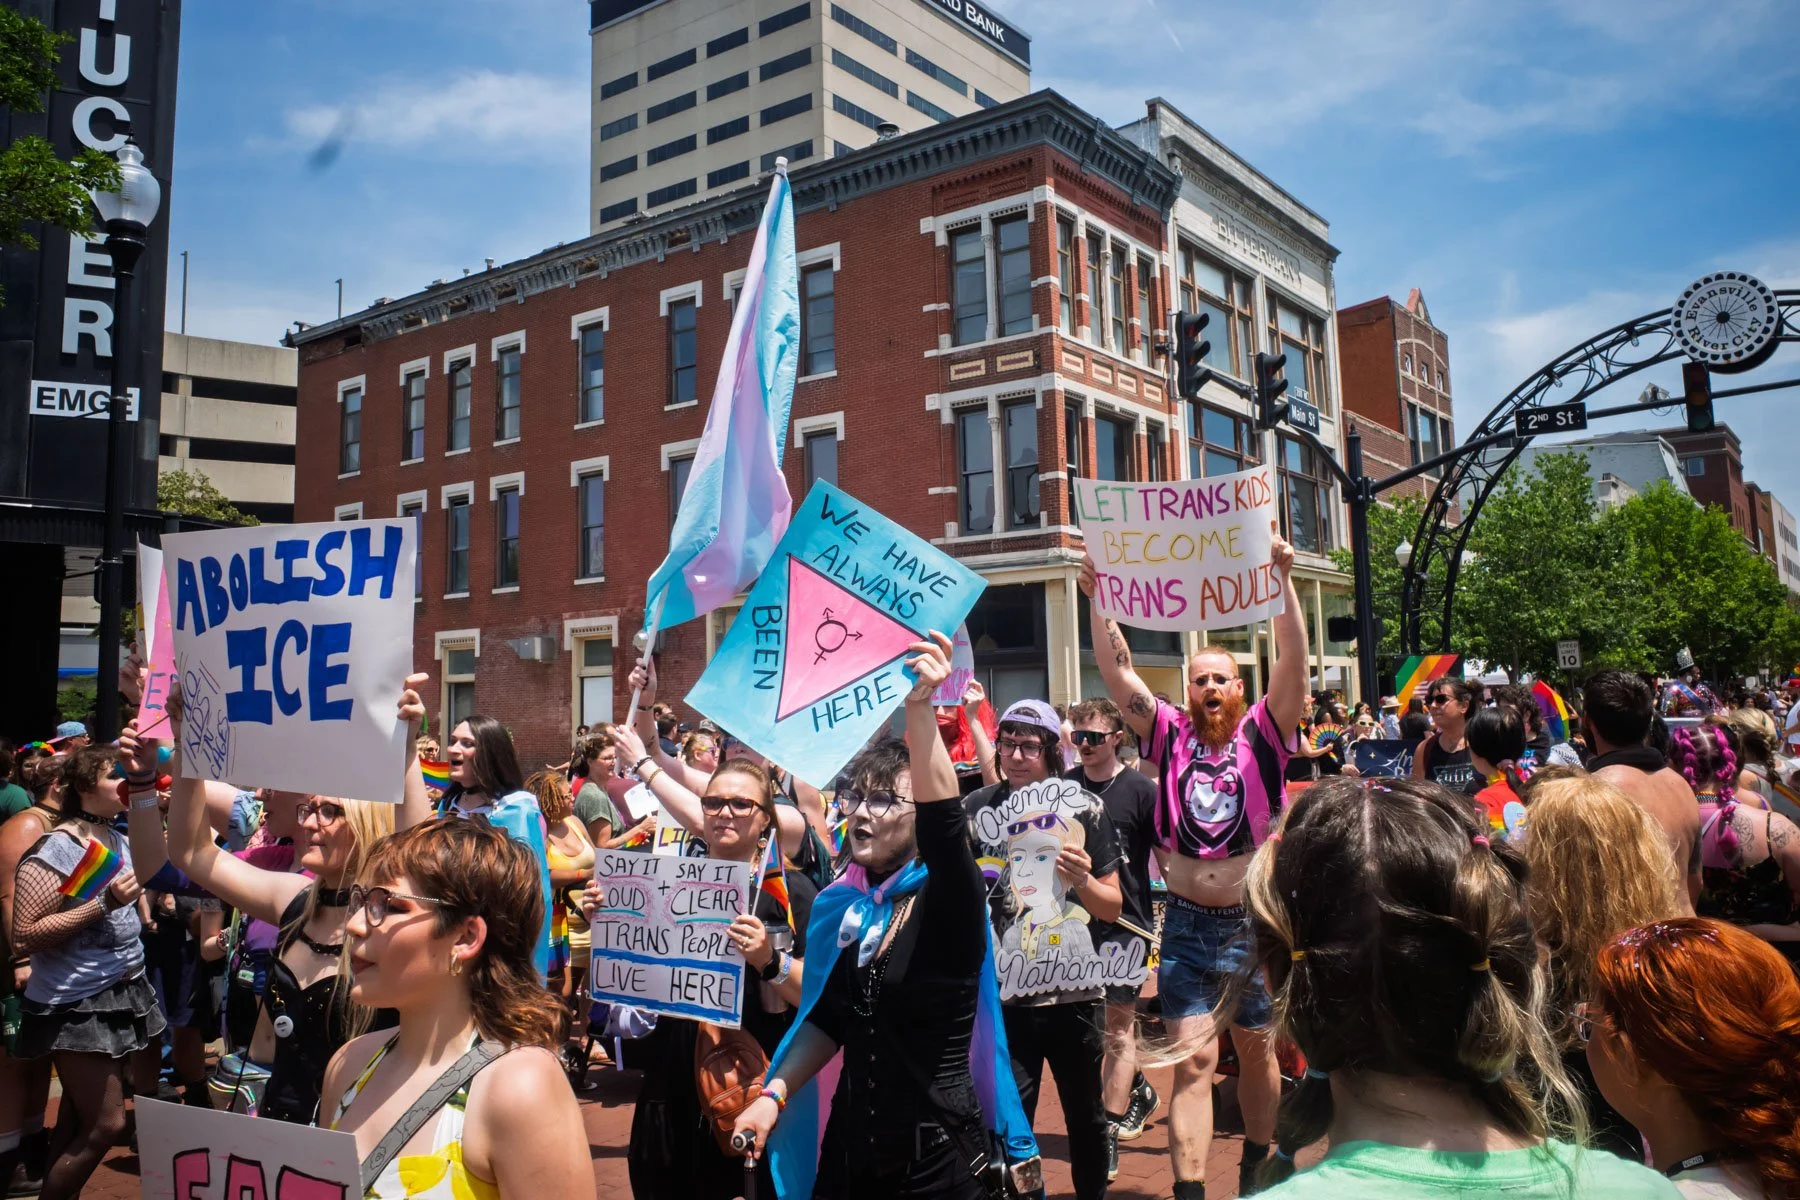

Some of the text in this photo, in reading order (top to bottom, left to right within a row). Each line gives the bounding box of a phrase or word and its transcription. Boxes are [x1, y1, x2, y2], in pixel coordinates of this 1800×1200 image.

[965, 2, 1005, 42] BANK
[1685, 286, 1758, 321] Evansville
[1688, 316, 1762, 350] River City
[1291, 403, 1316, 428] Main St
[1527, 410, 1574, 430] 2ND St
[1077, 470, 1271, 522] LET TRANS KIDS
[820, 493, 958, 599] WE HAVE
[1102, 524, 1244, 565] BECOME
[176, 525, 403, 637] ABOLISH
[812, 544, 925, 620] ALWAYS
[1095, 562, 1282, 621] TRANS ADULTS
[751, 605, 784, 690] BEEN
[1562, 655, 1577, 667] 10
[225, 619, 354, 725] ICE
[811, 671, 898, 733] HERE
[979, 782, 1087, 840] avenge
[599, 854, 661, 878] SAY IT
[676, 863, 738, 883] SAY IT
[670, 888, 742, 916] CLEAR
[1177, 899, 1208, 915] SAVAGE
[1218, 903, 1245, 916] FENTY
[596, 920, 670, 955] TRANS
[595, 957, 734, 1009] LIVE HERE
[999, 939, 1141, 990] Nathaniel
